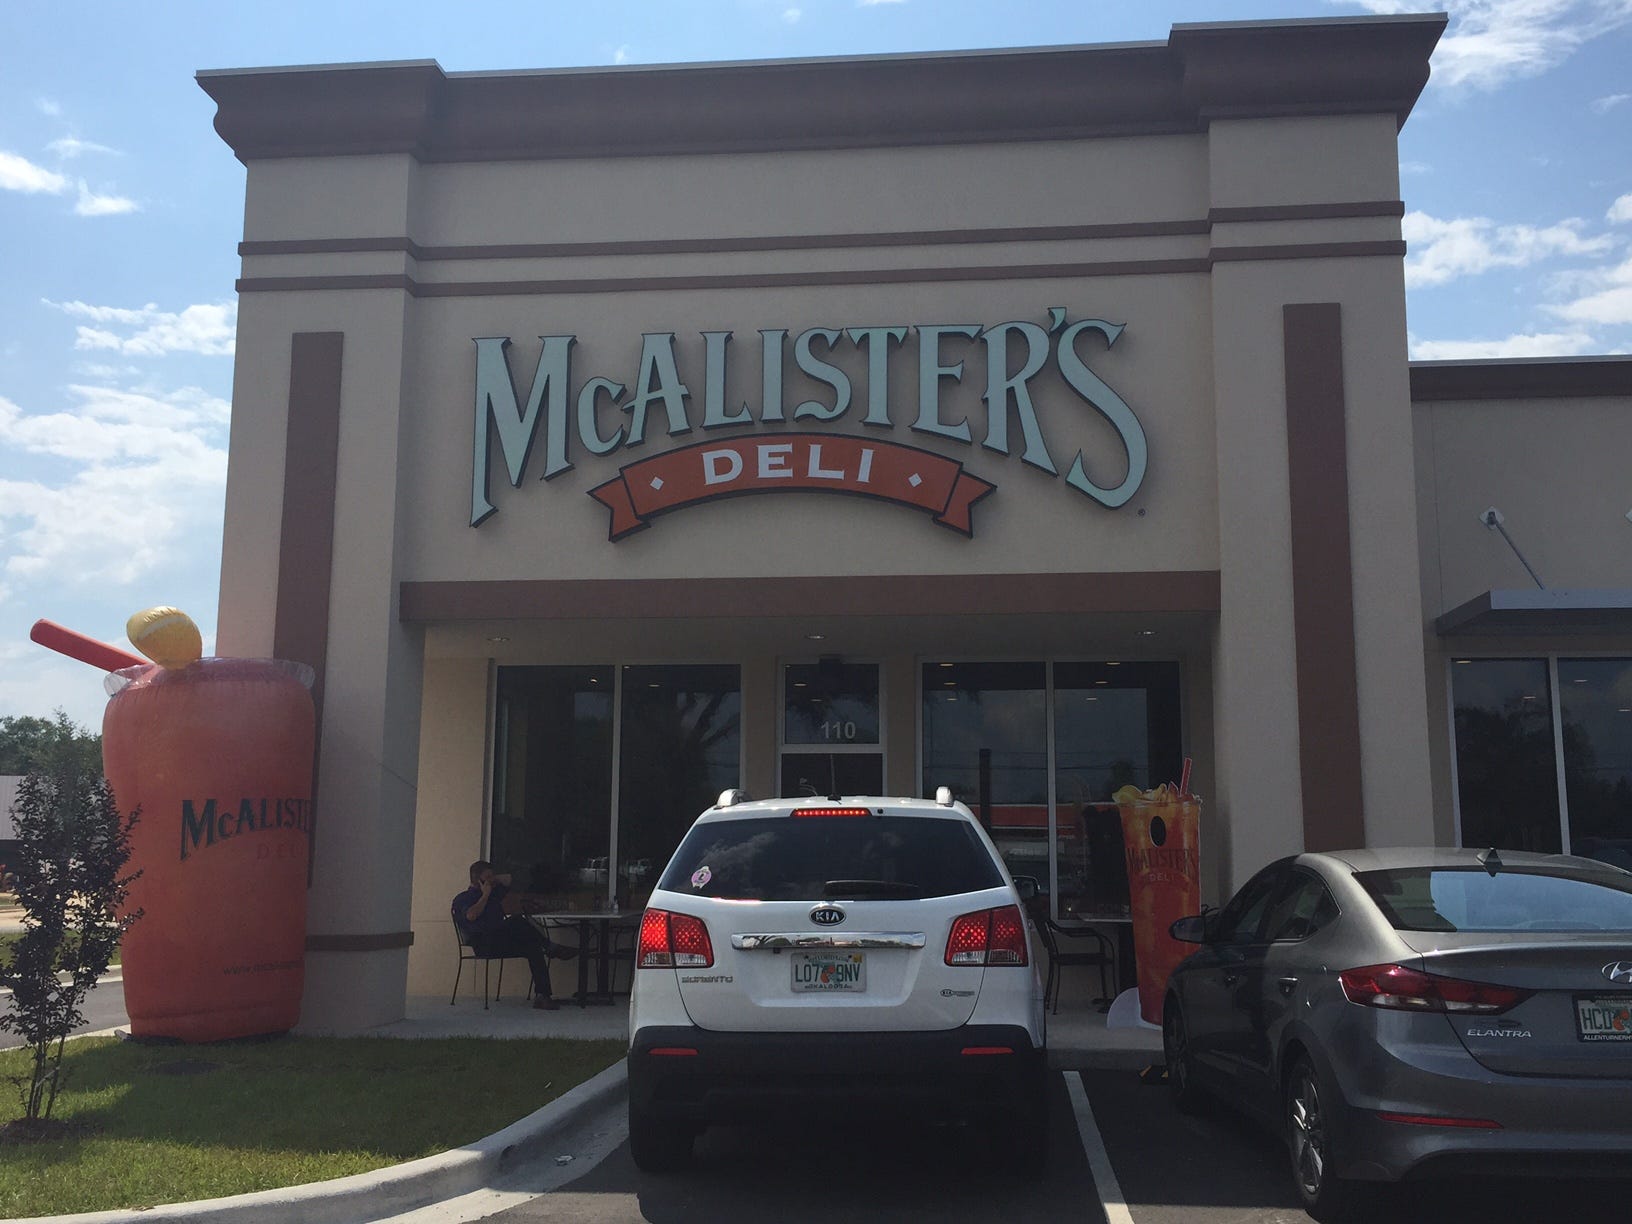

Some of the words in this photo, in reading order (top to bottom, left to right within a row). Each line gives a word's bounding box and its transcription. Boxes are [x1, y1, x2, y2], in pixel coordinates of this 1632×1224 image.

[702, 442, 873, 486] DELI
[820, 720, 856, 739] 110
[815, 911, 840, 922] KIA
[1466, 1028, 1532, 1038] ELANTRA
